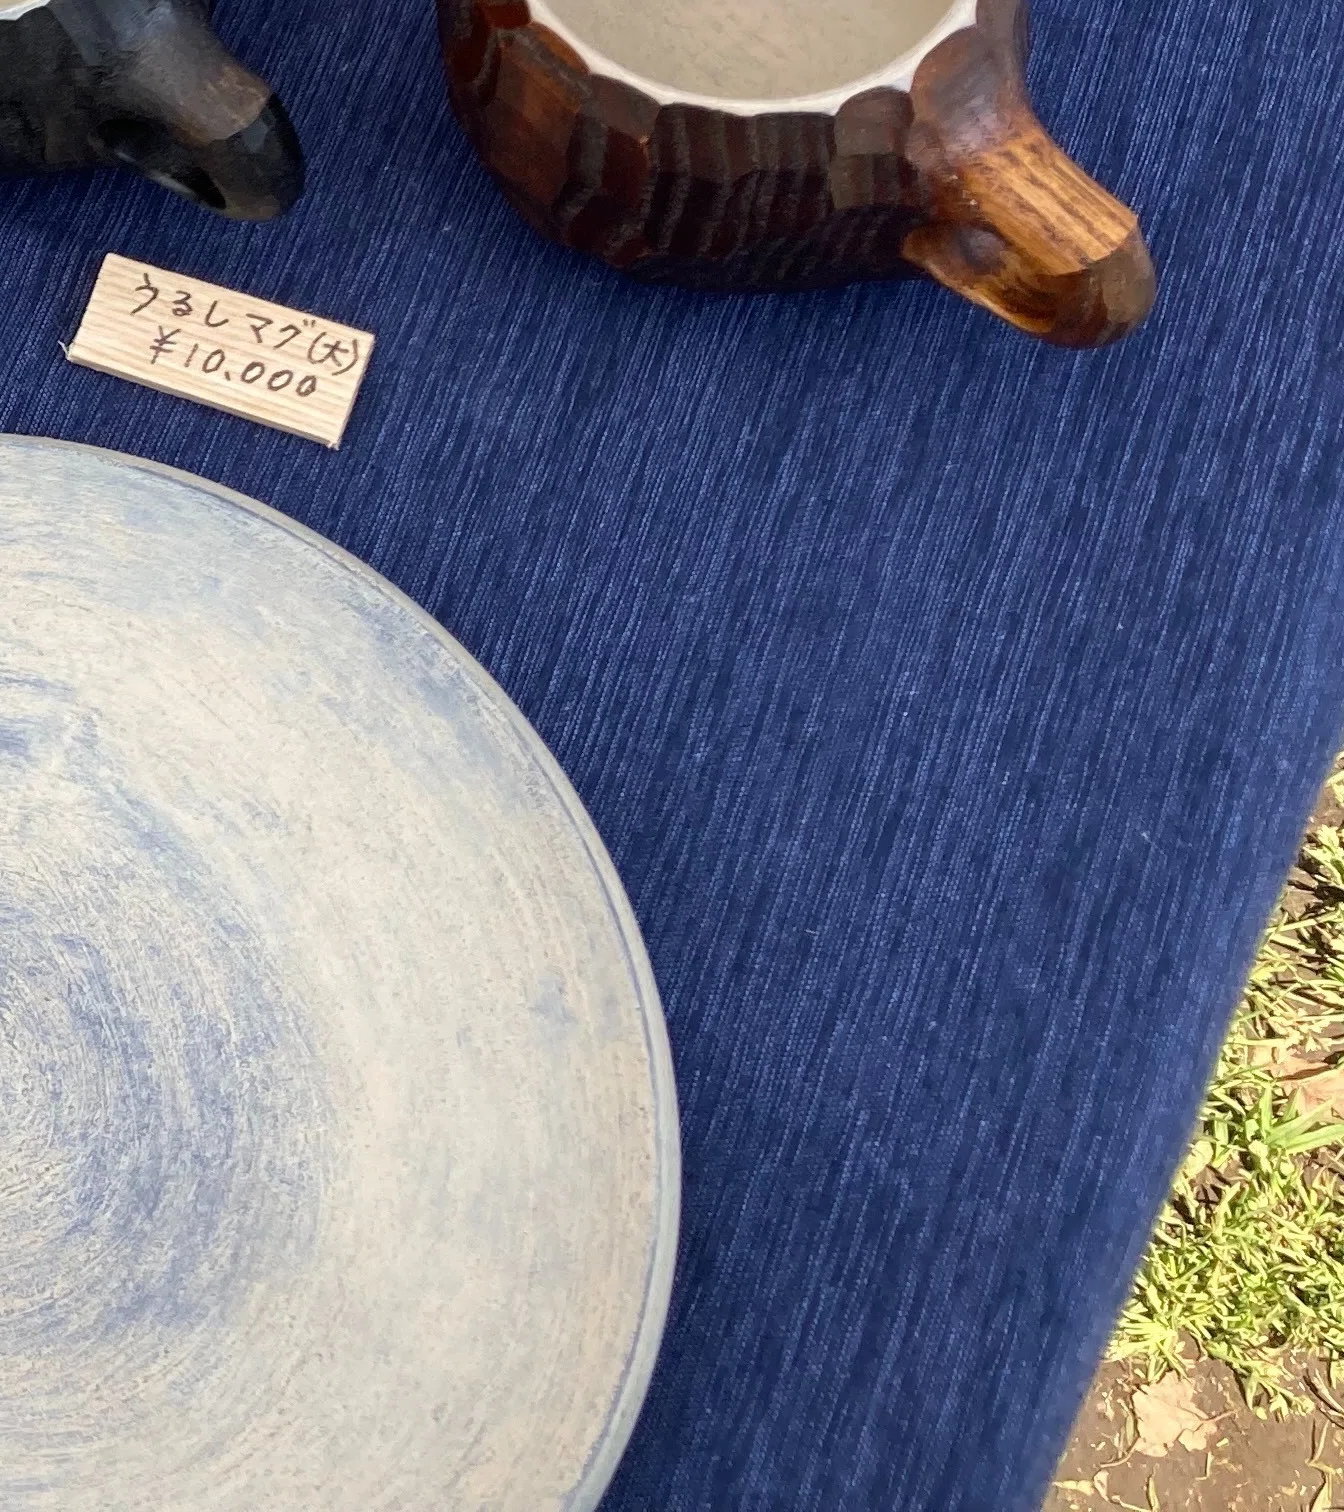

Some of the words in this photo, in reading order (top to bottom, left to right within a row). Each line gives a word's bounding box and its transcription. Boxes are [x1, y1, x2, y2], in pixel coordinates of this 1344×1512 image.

[130, 273, 360, 376] うるしマグ(大)
